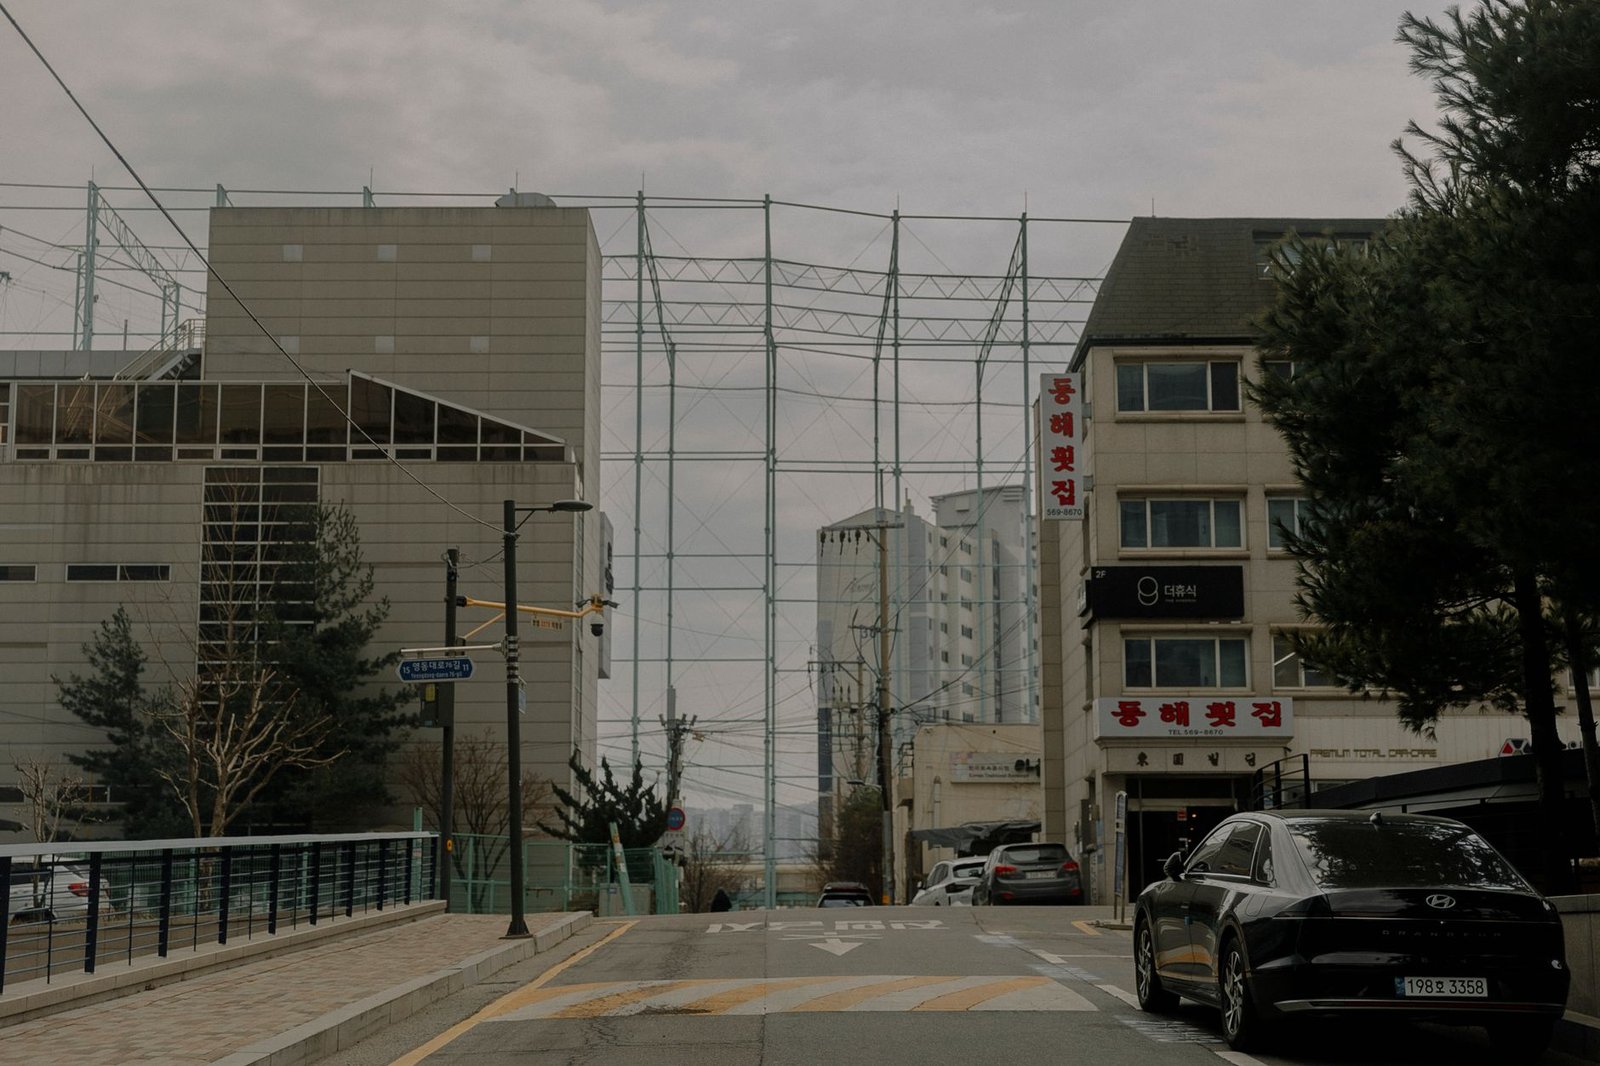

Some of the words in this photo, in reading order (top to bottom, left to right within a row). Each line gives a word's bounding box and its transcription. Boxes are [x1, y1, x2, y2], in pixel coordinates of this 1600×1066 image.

[1048, 378, 1076, 506] 동해횟집
[1046, 508, 1082, 517] 569-8670
[1095, 570, 1106, 579] 2F
[1164, 584, 1197, 597] 더휴식
[1110, 700, 1281, 727] 동해횟집
[1310, 748, 1351, 758] PREMIUM
[1353, 748, 1386, 758] TOTAL
[1407, 978, 1445, 994] 198호
[1449, 979, 1484, 994] 3358
